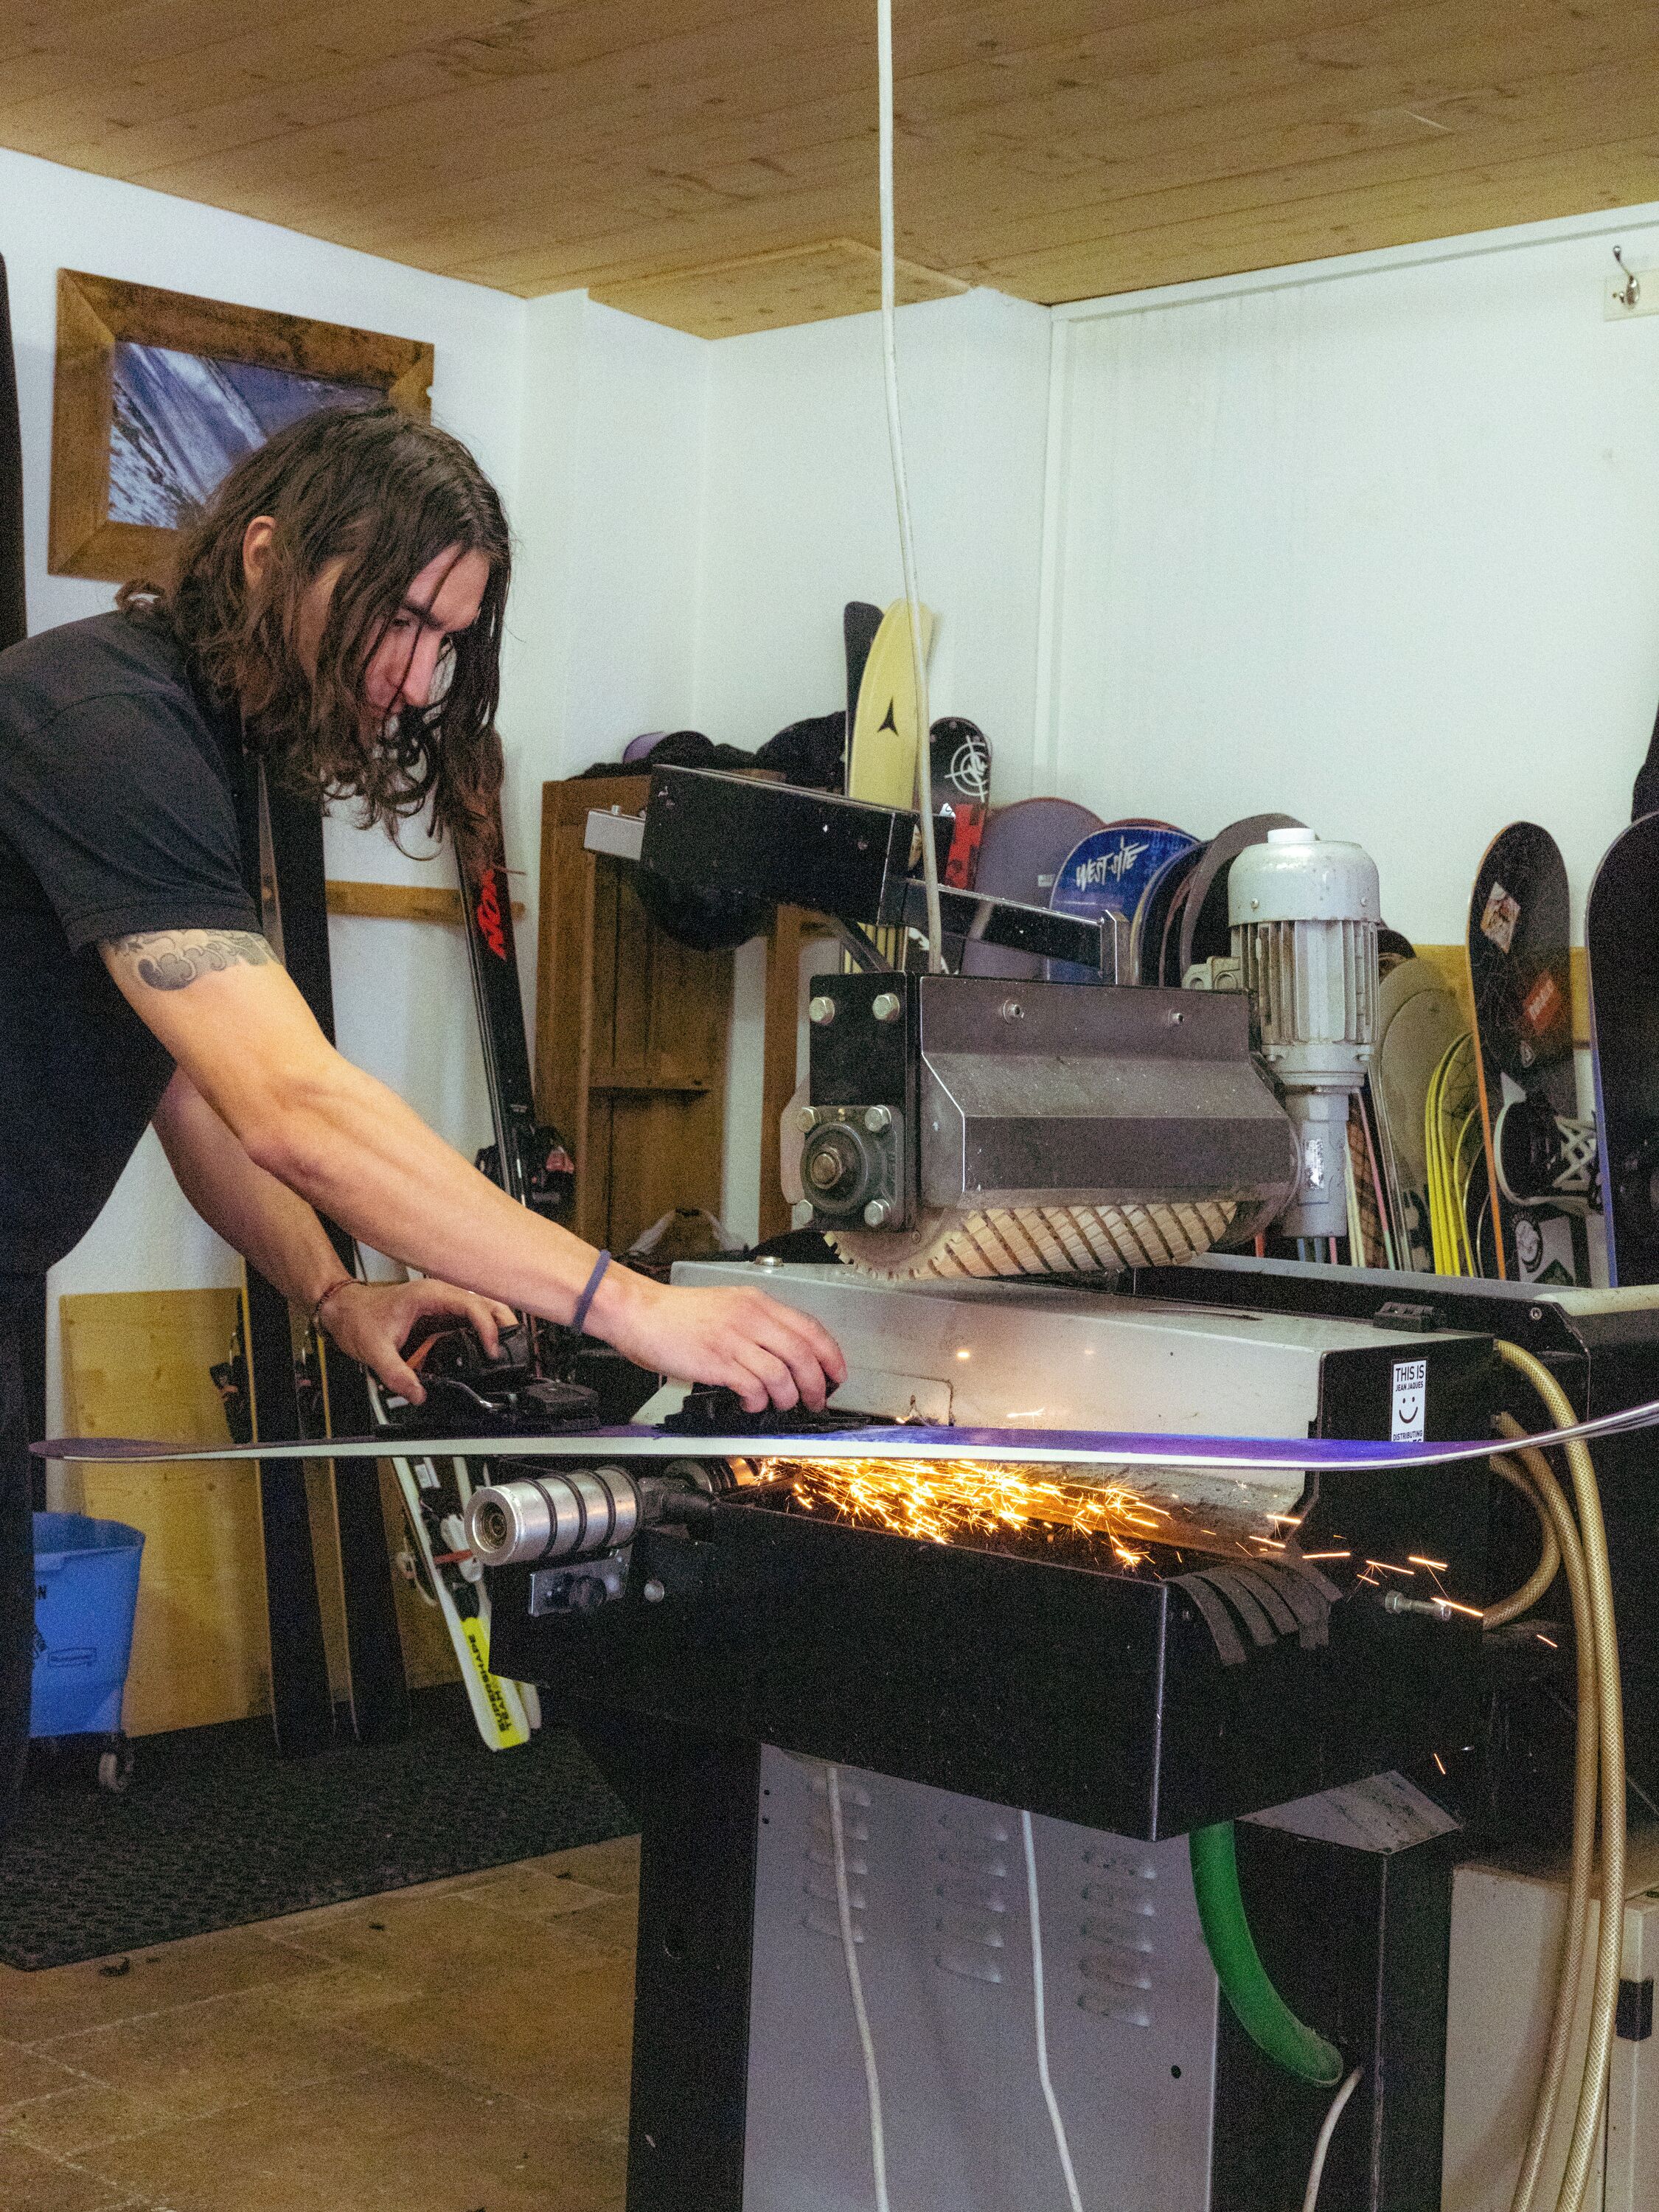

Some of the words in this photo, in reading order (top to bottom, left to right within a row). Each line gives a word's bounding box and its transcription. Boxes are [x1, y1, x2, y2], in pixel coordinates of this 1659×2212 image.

[1395, 1366, 1415, 1382] THIS
[1416, 1364, 1425, 1380] IS
[1395, 1384, 1407, 1392] JEAN
[1407, 1381, 1424, 1391] JAQUES
[1393, 1430, 1423, 1441] DISTRIBUTING
[468, 1634, 506, 1732] SUPERSHAPE
